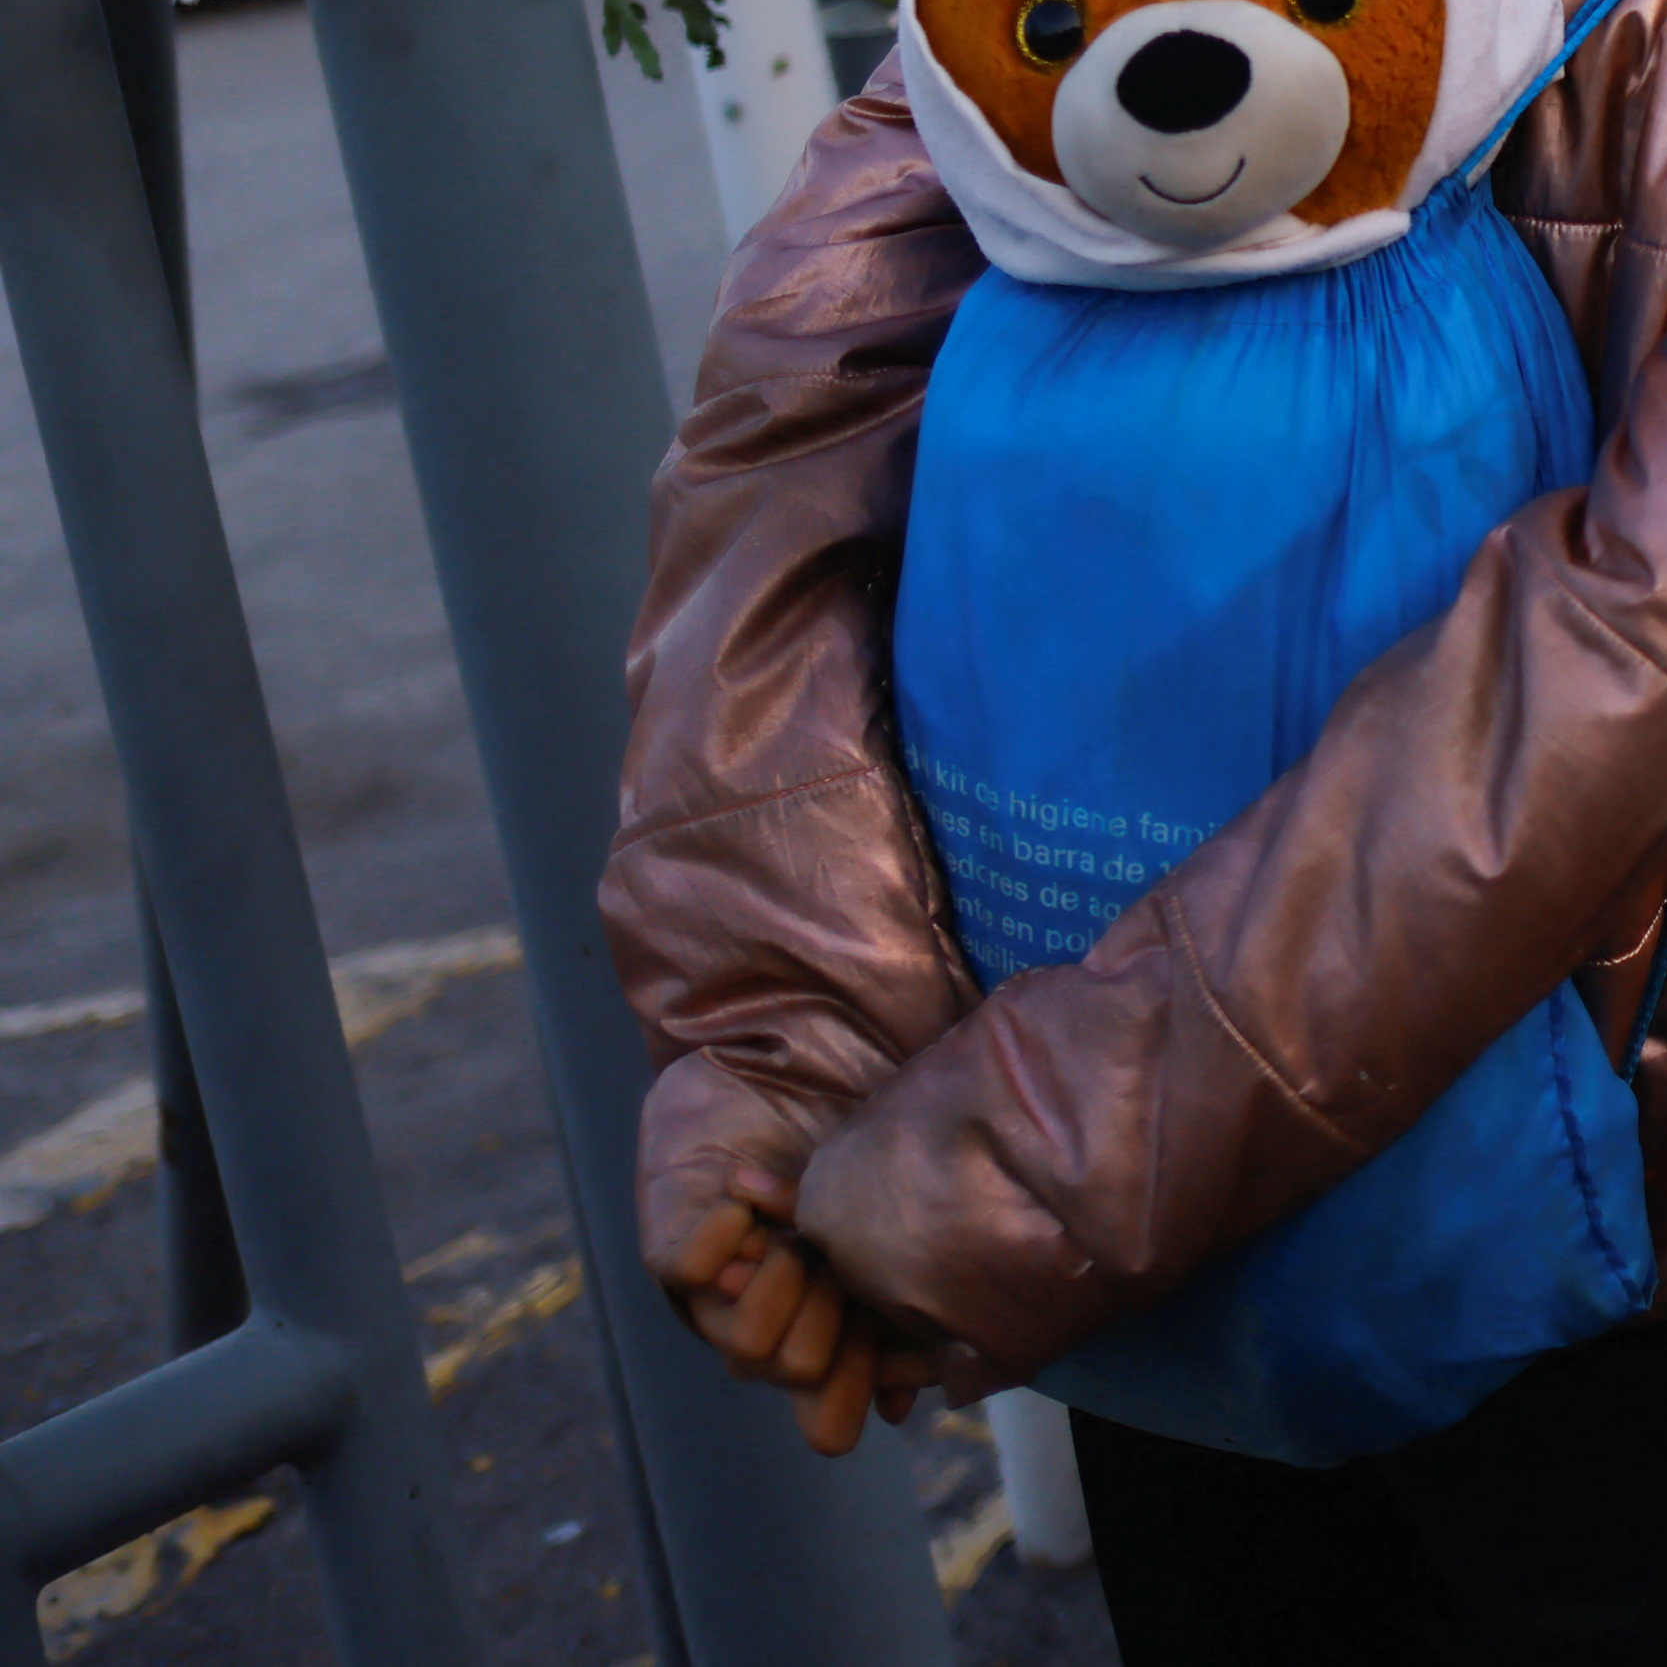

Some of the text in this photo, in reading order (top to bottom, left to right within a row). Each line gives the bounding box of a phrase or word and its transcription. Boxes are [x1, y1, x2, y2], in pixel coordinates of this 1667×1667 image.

[934, 759, 968, 796] kit
[1008, 789, 1128, 838] higiene
[1138, 811, 1224, 848] fami
[945, 851, 1030, 902] edores
[1039, 881, 1080, 912] de
[1012, 832, 1095, 875] barra
[1103, 853, 1146, 884] de
[1001, 914, 1034, 943] en
[1045, 927, 1094, 955] pol
